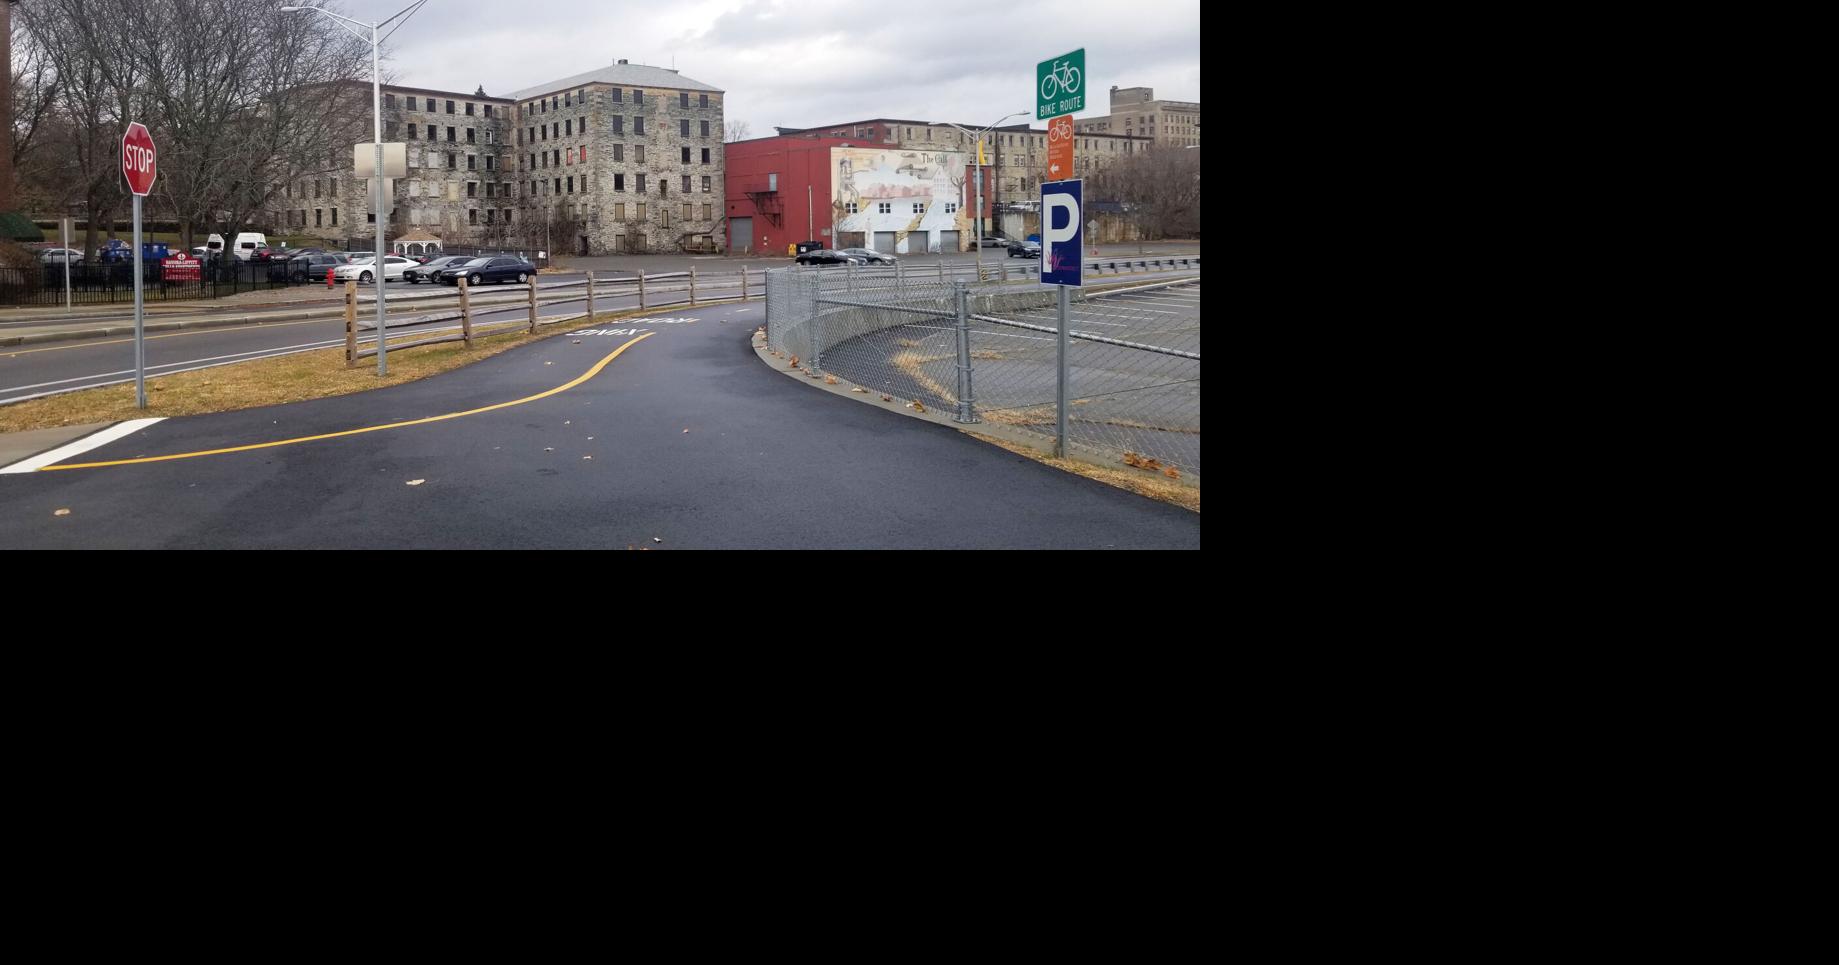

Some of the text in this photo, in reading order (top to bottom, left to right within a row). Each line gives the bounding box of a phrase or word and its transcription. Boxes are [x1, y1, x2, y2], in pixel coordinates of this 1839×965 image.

[1040, 95, 1081, 117] BIKE ROUTE
[126, 143, 153, 174] STOP
[921, 152, 933, 164] The
[1043, 193, 1079, 273] P
